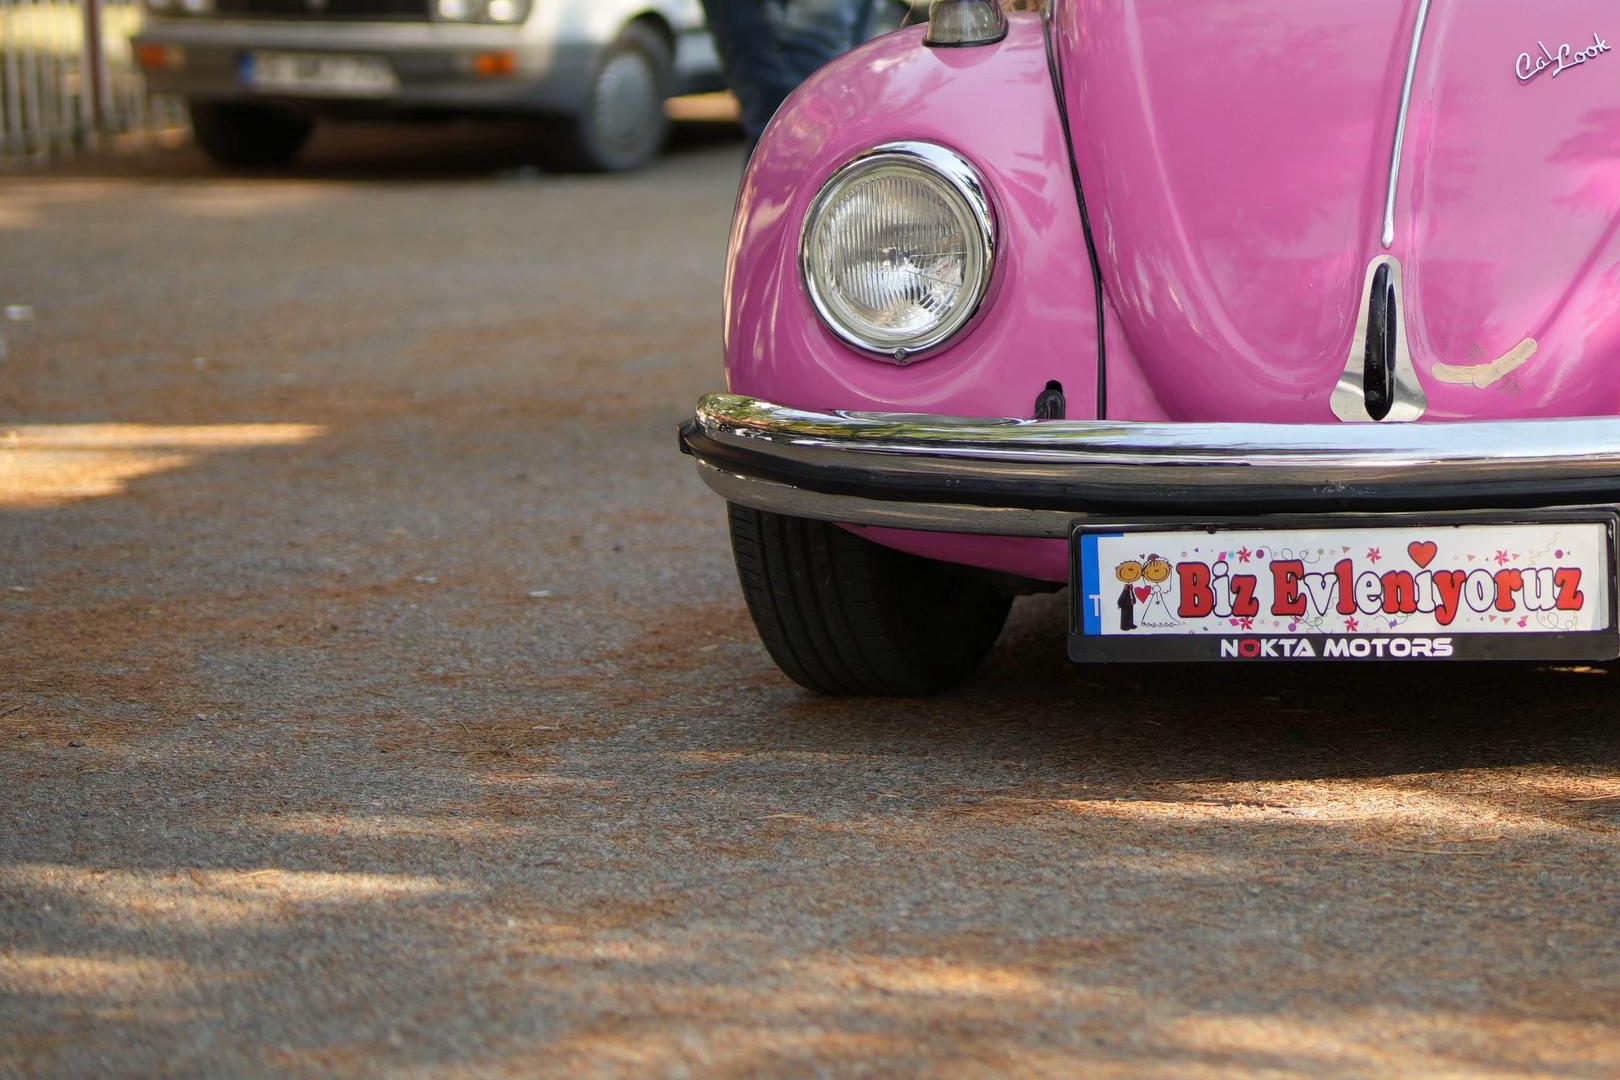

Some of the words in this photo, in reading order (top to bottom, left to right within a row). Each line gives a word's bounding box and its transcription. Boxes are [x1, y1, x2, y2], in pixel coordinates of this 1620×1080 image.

[1514, 40, 1554, 81] Cal
[1552, 32, 1612, 78] Look
[1176, 560, 1260, 619] Biz
[1269, 557, 1585, 626] Evleniyoruz
[1220, 637, 1315, 658] NOKTA
[1323, 637, 1454, 658] MOTORS
